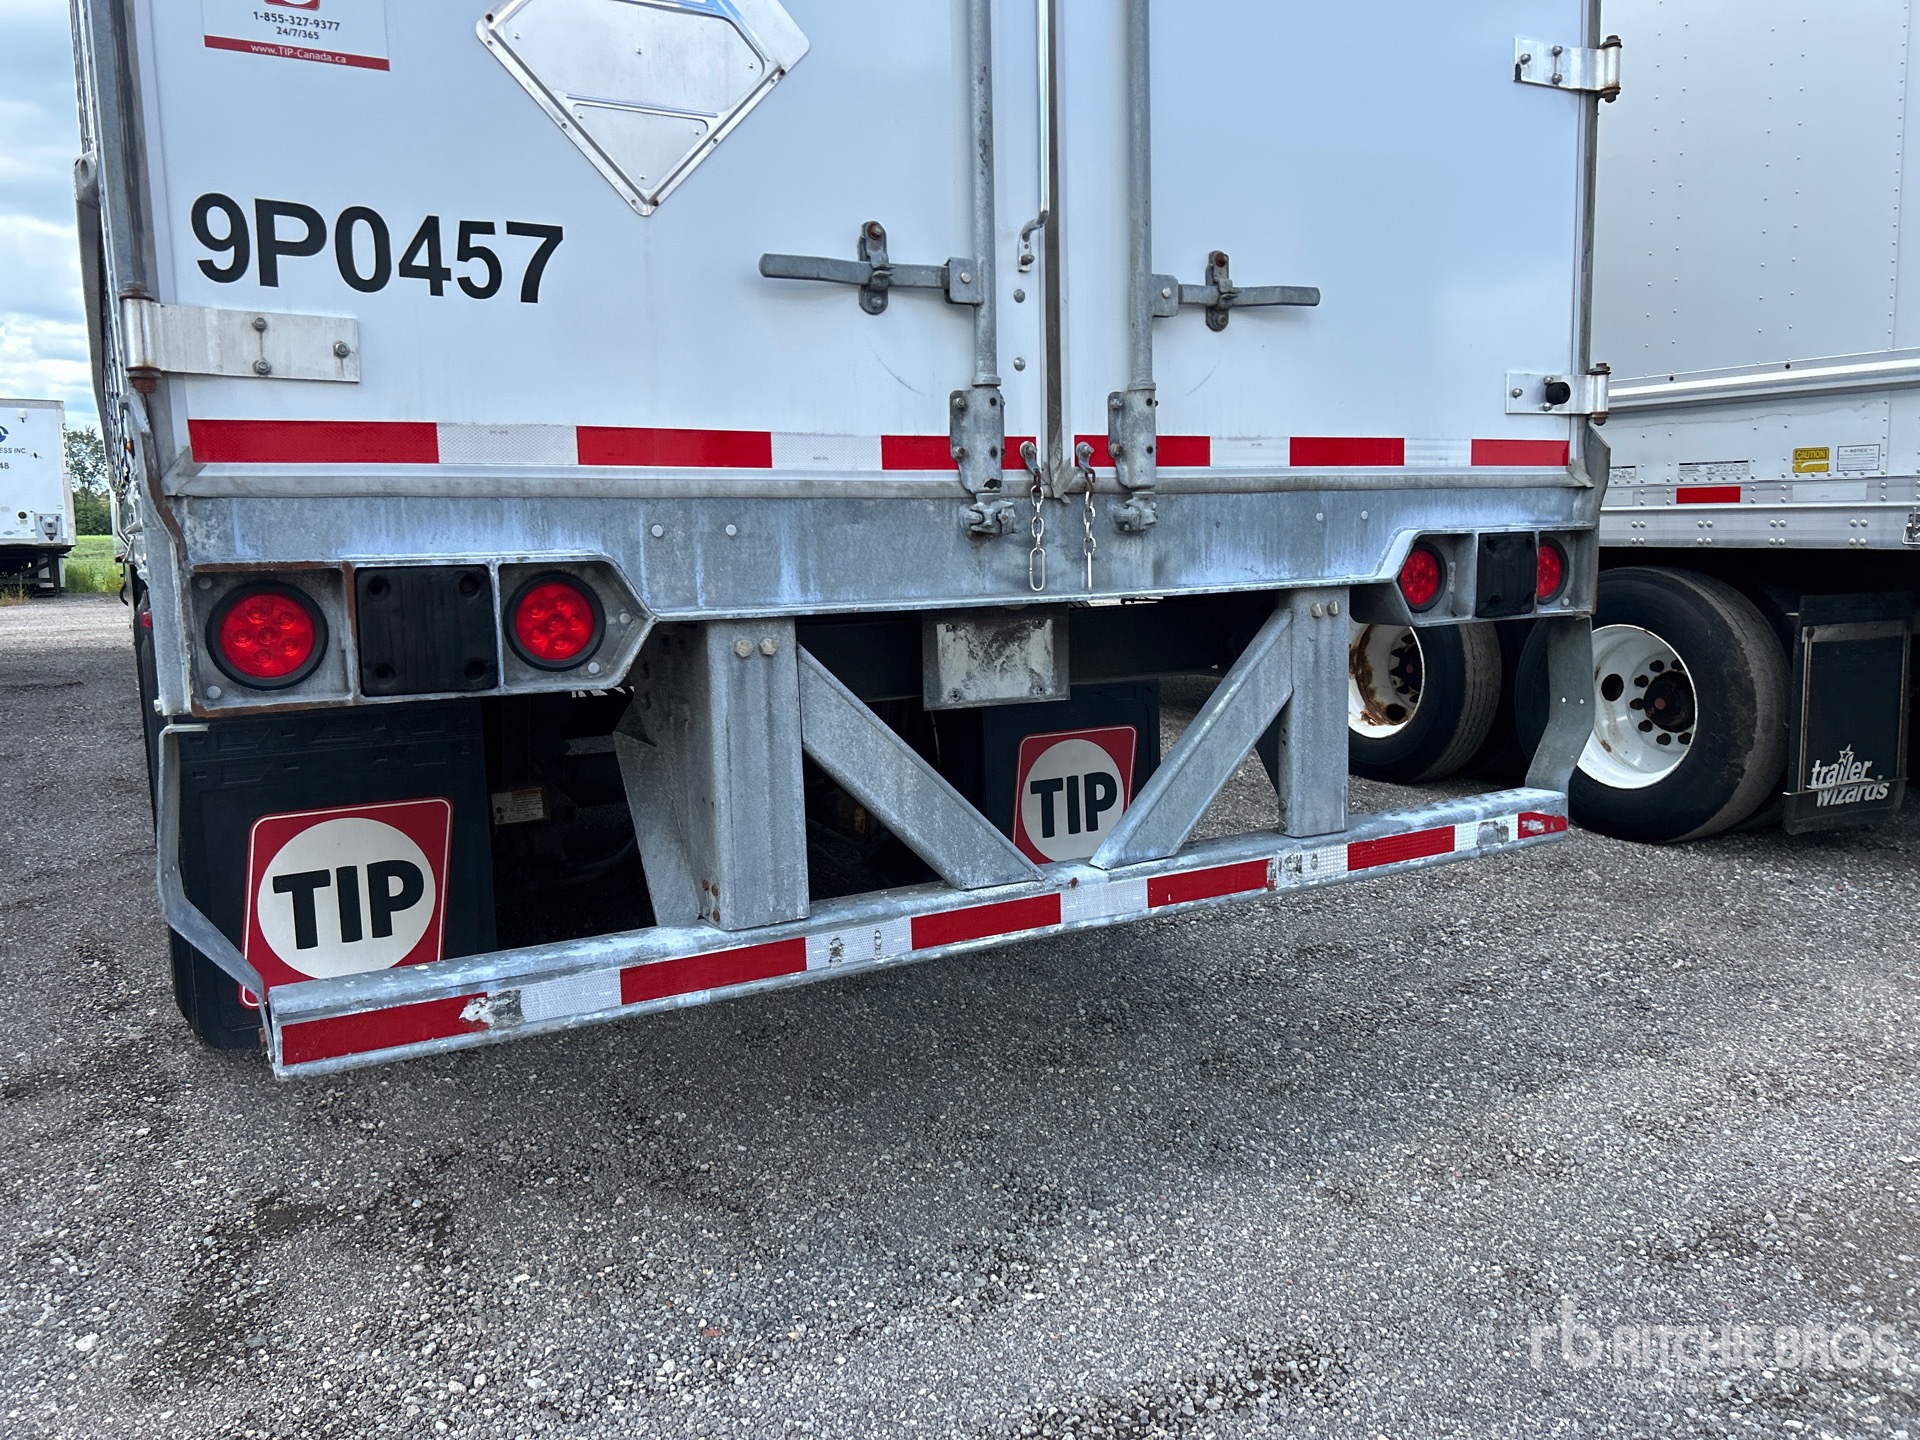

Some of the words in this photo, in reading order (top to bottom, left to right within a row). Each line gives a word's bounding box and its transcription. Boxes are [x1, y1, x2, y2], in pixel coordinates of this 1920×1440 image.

[253, 11, 340, 31] 1-855-327-9377
[276, 26, 319, 40] 24/7/365
[250, 44, 347, 64] www.TIP-Canada.ca
[190, 192, 564, 304] 9P0457
[1796, 449, 1826, 459] CAUTION
[1811, 755, 1873, 787] trailer
[1030, 771, 1118, 839] TIP
[1816, 775, 1890, 808] wizards
[272, 859, 425, 950] TIP
